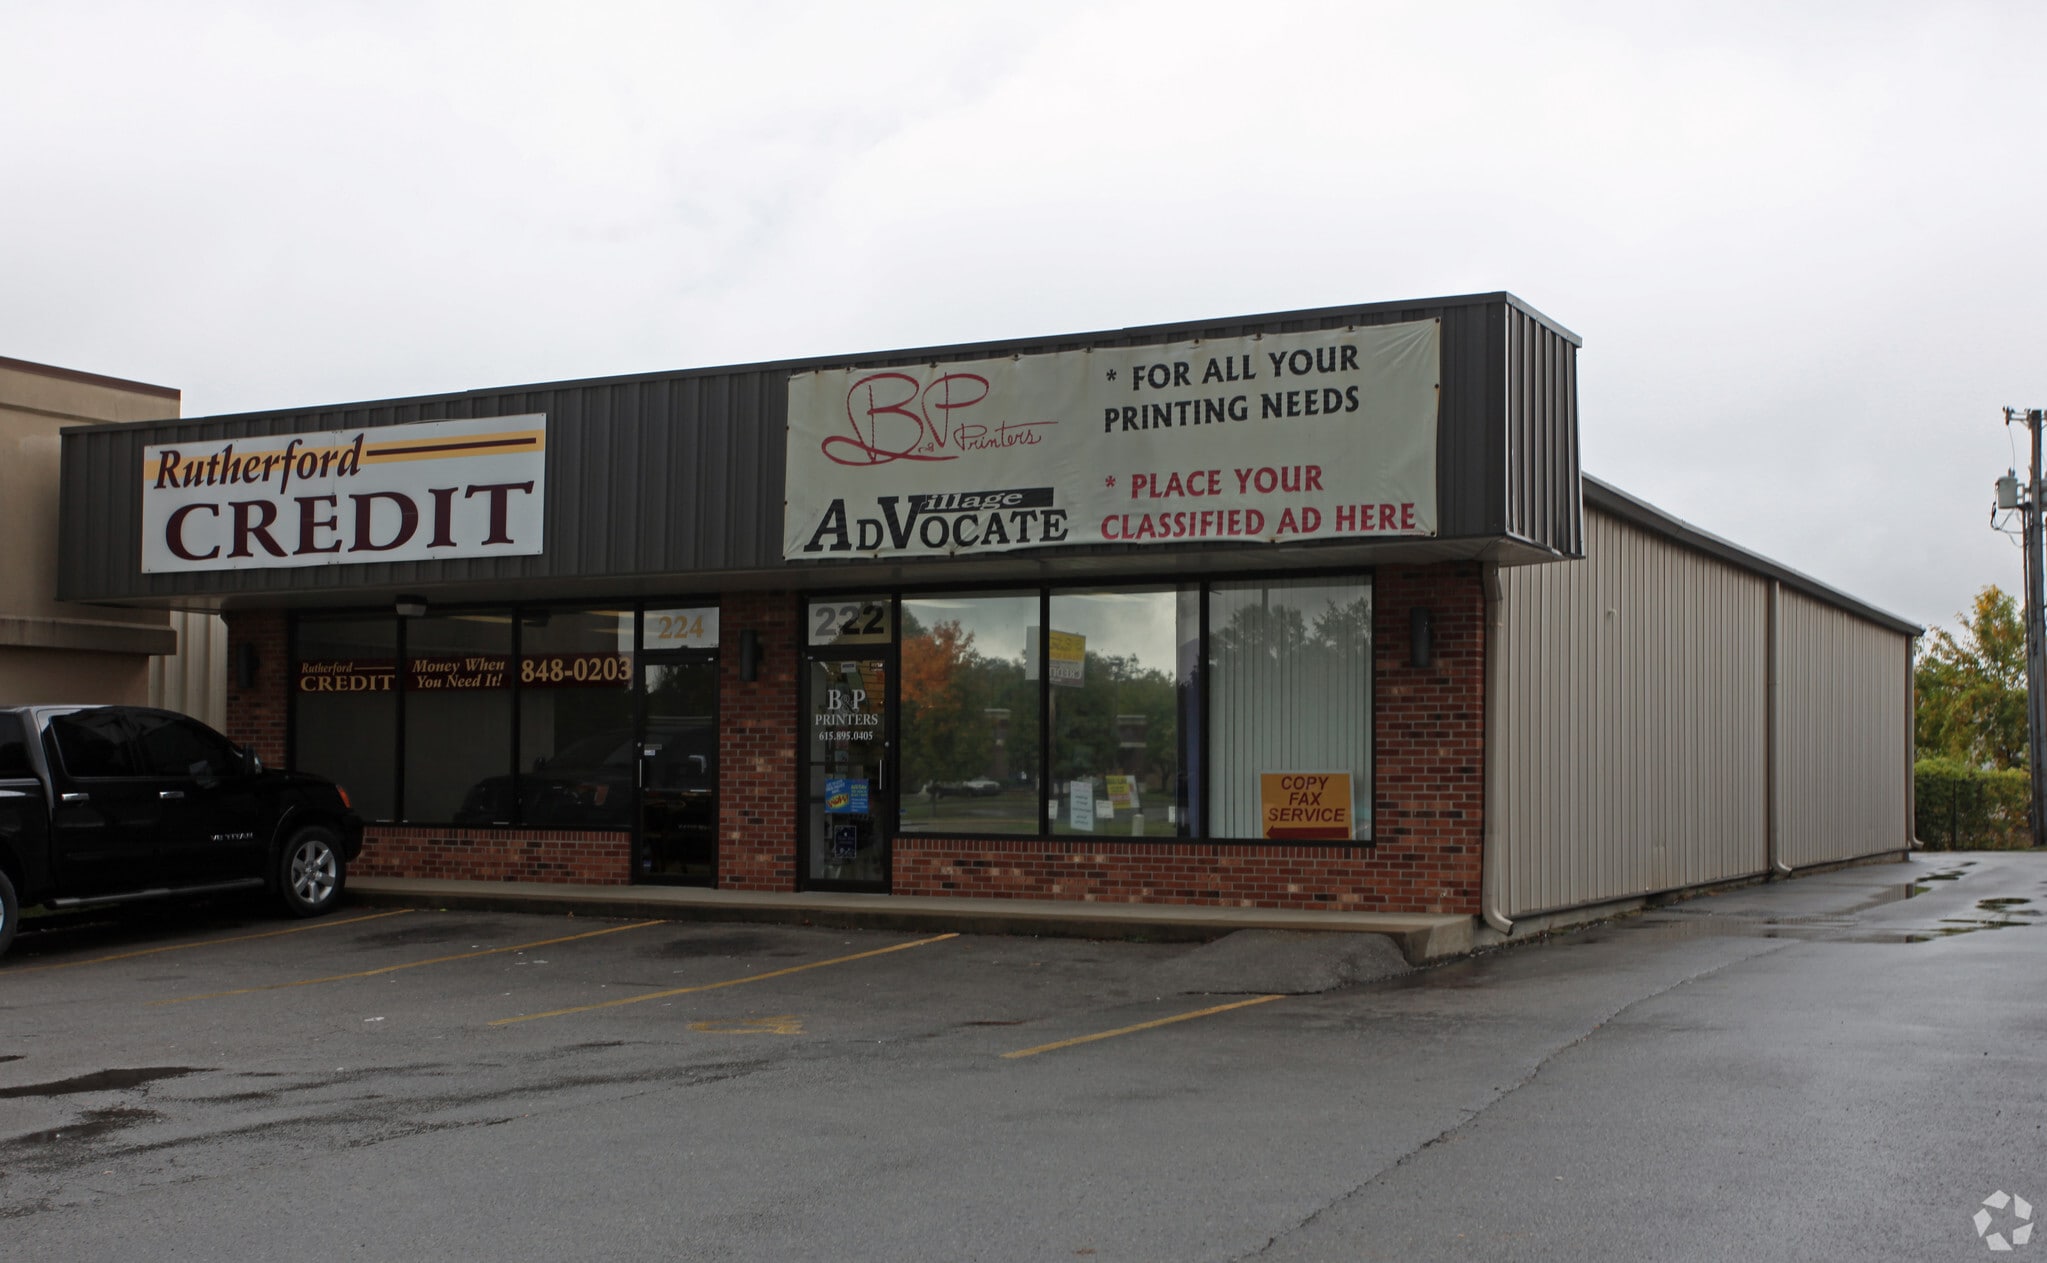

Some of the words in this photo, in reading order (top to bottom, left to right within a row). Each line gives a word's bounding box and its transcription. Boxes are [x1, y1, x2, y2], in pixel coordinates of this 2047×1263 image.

[1132, 361, 1191, 391] FOR
[1202, 355, 1256, 384] ALL
[1268, 345, 1360, 377] YOUR
[1104, 395, 1248, 433] PRINTING
[1260, 386, 1360, 419] NEEDS
[153, 432, 364, 494] Rutherford
[1131, 469, 1222, 499] PLACE
[1234, 464, 1324, 494] YOUR
[165, 480, 535, 561] CREDIT
[1101, 508, 1265, 540] CLASSIFIED
[1276, 506, 1322, 534] AD
[1335, 503, 1416, 532] HERE
[658, 614, 704, 639] 224
[815, 604, 885, 636] 222
[301, 661, 353, 675] Rutherford
[412, 659, 460, 676] Money
[465, 657, 505, 671] When
[521, 656, 633, 682] 848-0203
[300, 674, 395, 692] CREDIT
[416, 674, 443, 688] You
[447, 673, 484, 688] Need
[486, 672, 503, 687] It!
[815, 713, 879, 726] PRINTERS
[818, 730, 873, 741] 615.895.0405
[1281, 776, 1329, 791] COPY
[1289, 792, 1322, 806] FAX
[1268, 807, 1345, 822] SERVICE
